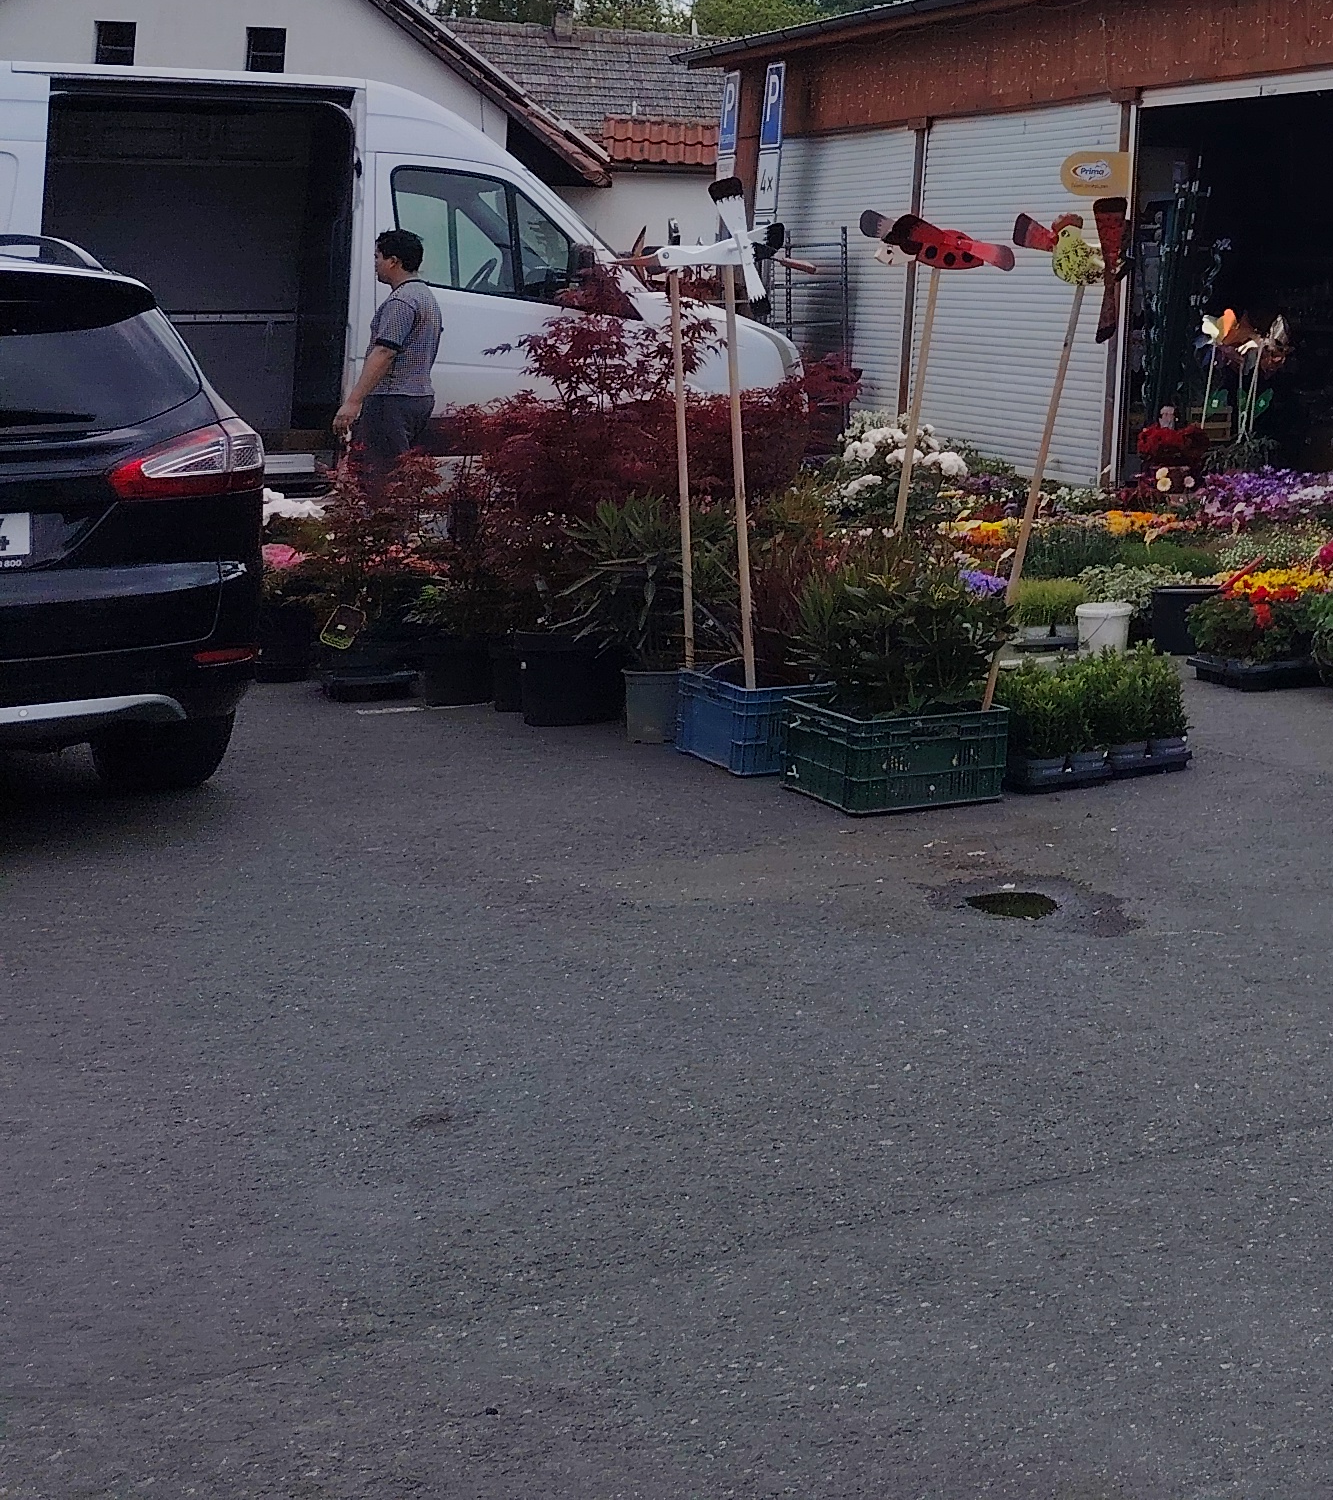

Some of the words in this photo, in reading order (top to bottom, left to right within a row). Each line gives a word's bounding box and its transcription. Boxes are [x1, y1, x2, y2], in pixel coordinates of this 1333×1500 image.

[723, 83, 735, 128] P
[766, 74, 780, 122] P
[4, 559, 22, 567] 800
